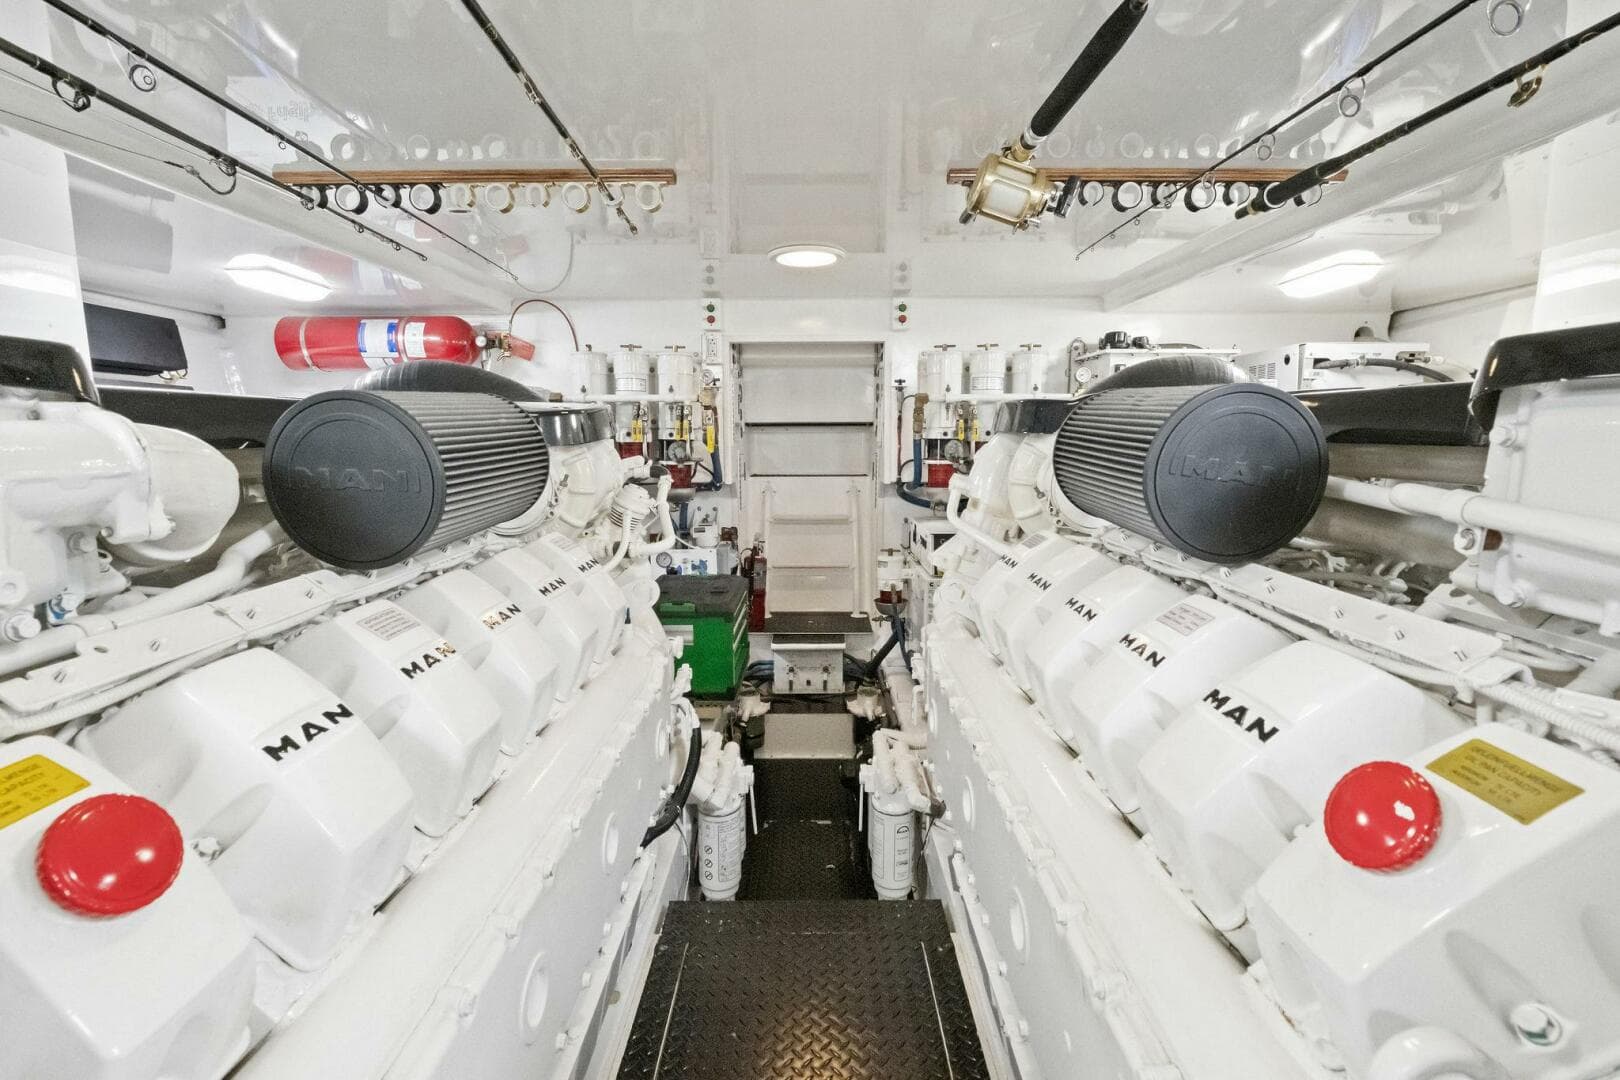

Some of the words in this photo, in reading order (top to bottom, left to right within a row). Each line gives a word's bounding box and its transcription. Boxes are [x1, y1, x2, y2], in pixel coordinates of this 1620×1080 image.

[577, 558, 600, 573] MAN
[1000, 554, 1018, 568] MAN
[539, 577, 566, 596] MAN
[1027, 573, 1052, 590] MAN
[483, 603, 521, 630] MAN
[1065, 597, 1097, 622] MAN
[400, 641, 456, 679] MAN
[1119, 633, 1166, 668] MAN
[1203, 688, 1279, 743] MAN
[262, 703, 353, 762] MAN
